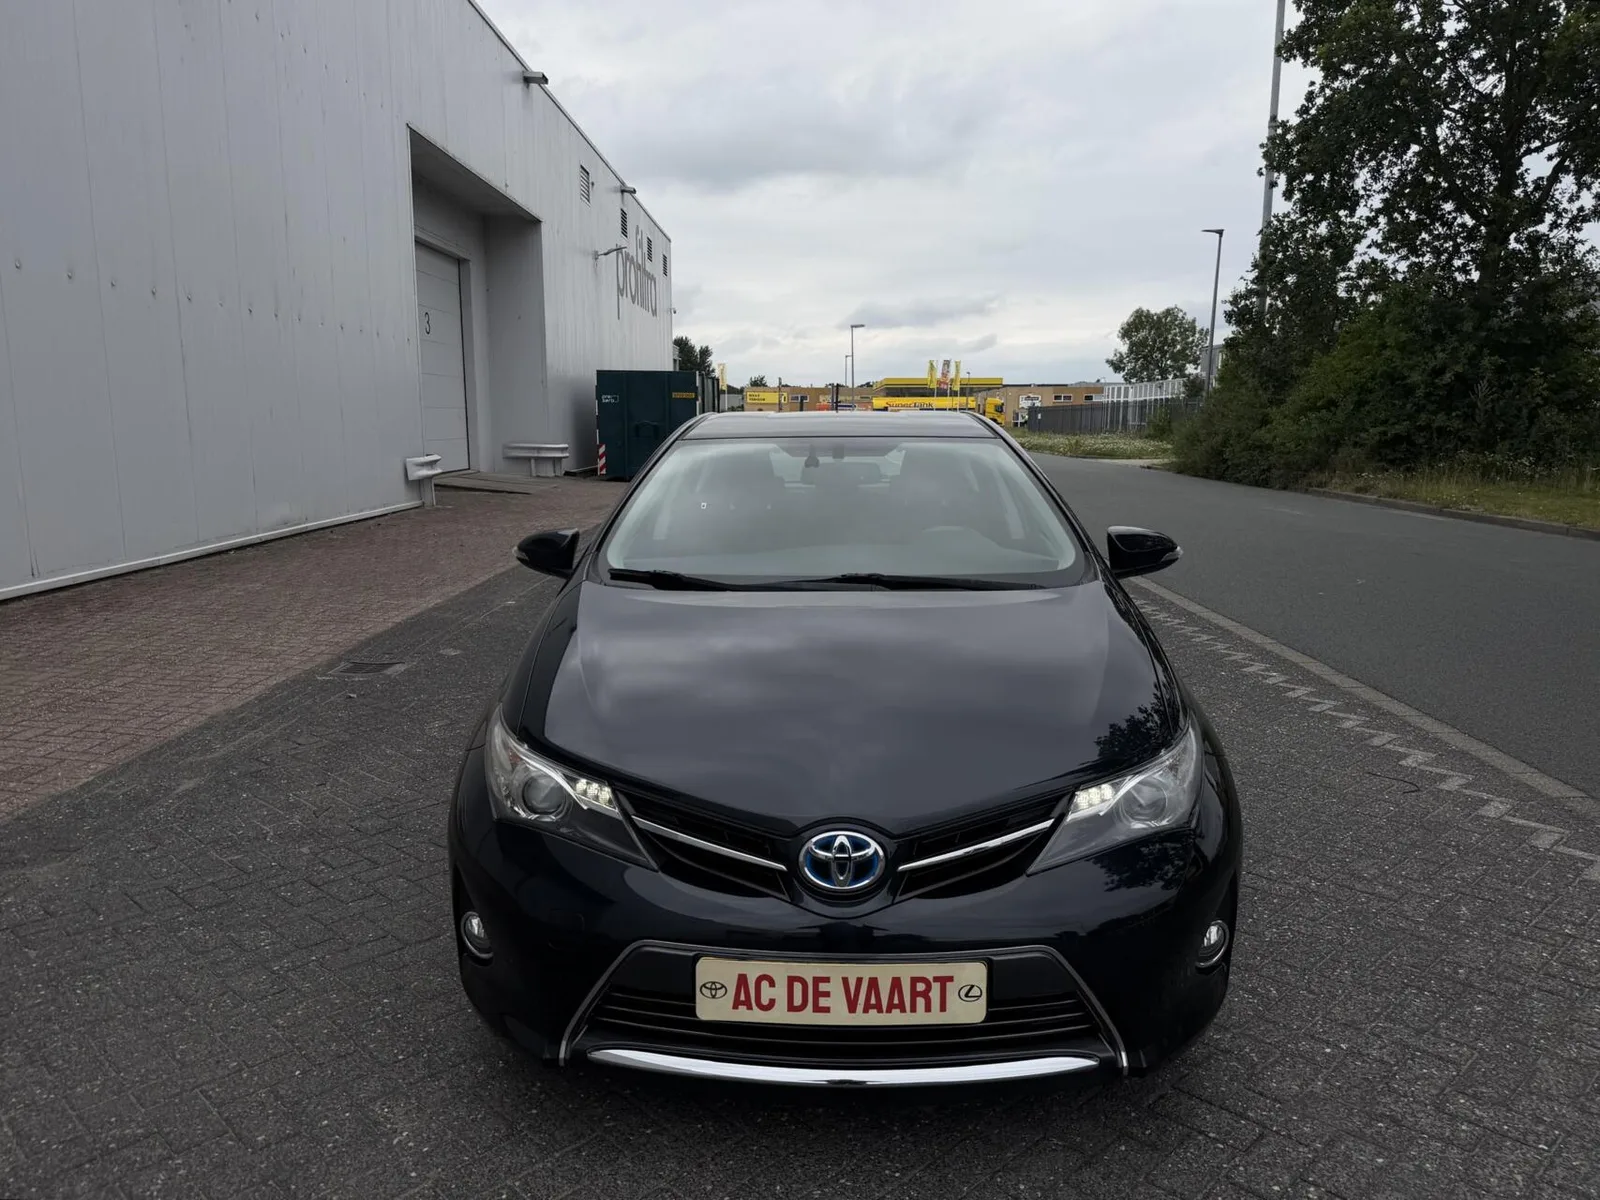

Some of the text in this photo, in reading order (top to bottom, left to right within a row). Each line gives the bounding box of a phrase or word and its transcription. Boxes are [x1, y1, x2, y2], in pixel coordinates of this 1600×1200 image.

[616, 224, 657, 320] profiltra
[424, 312, 431, 335] 3
[731, 973, 954, 1014] AC DE VAART
